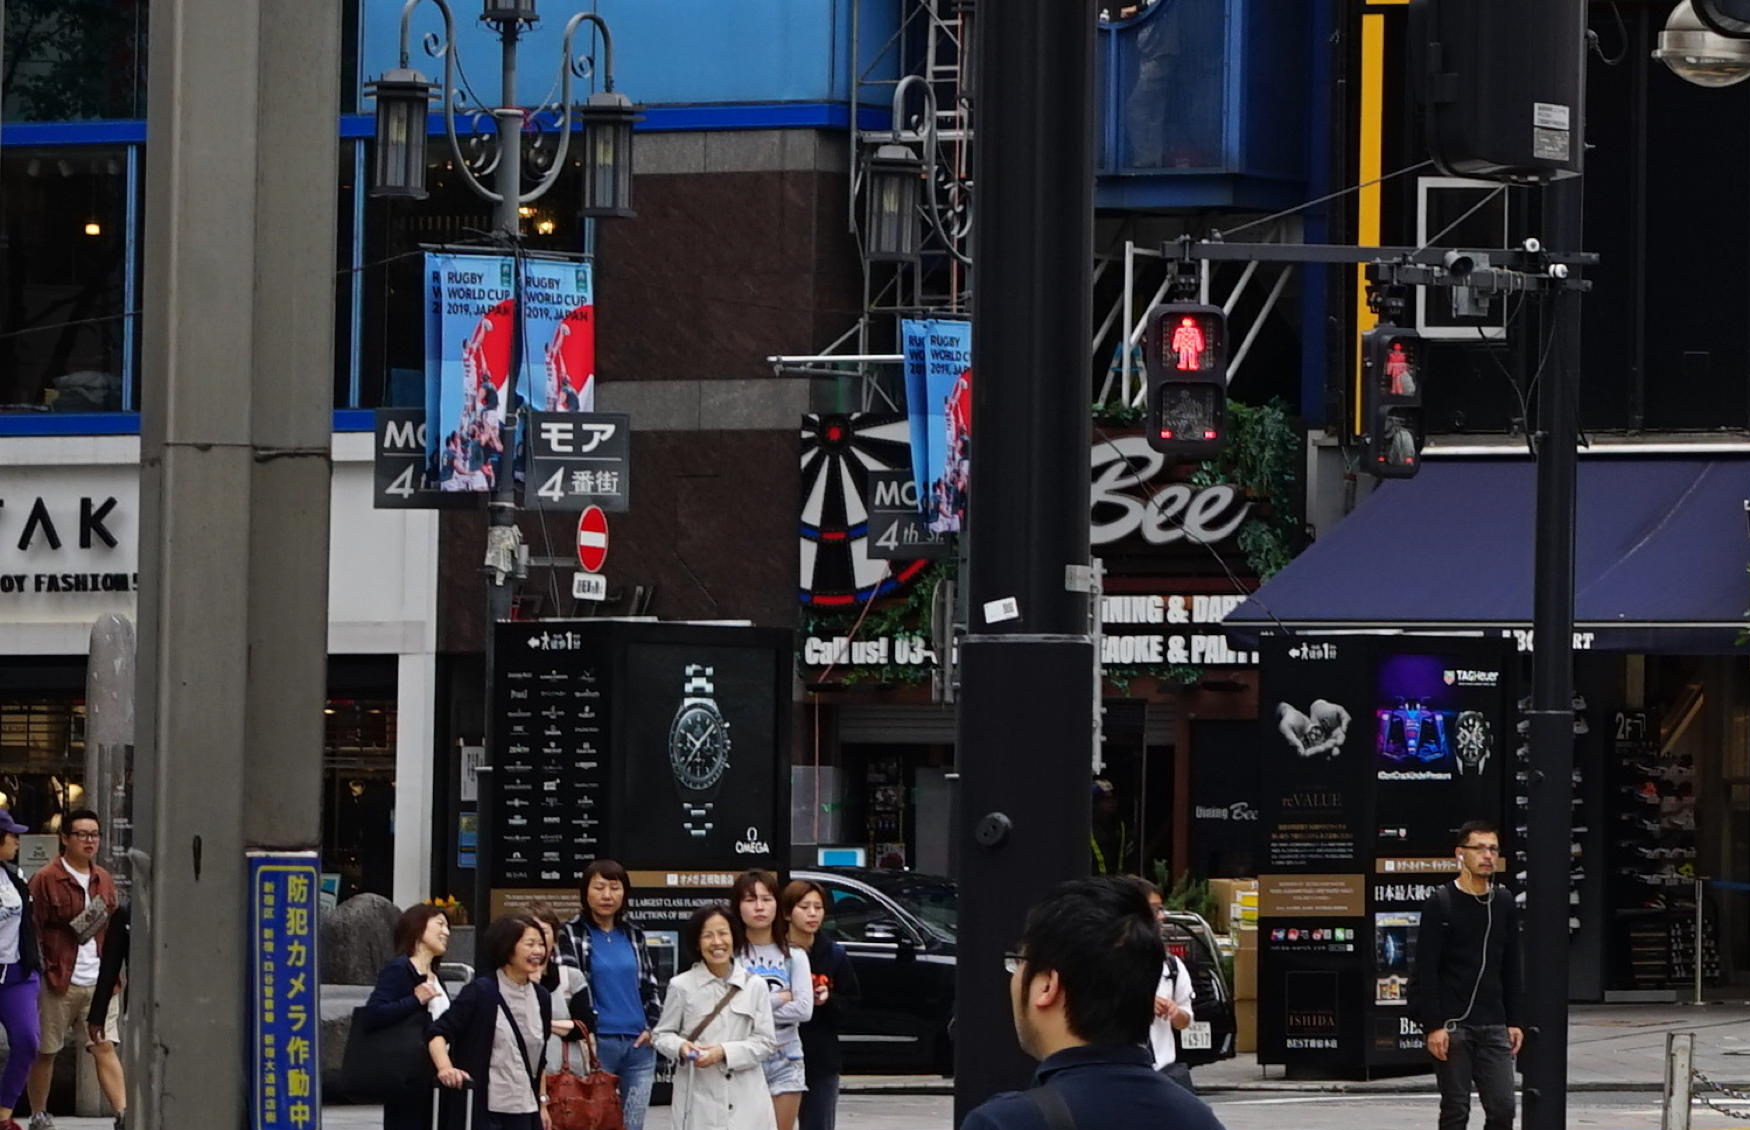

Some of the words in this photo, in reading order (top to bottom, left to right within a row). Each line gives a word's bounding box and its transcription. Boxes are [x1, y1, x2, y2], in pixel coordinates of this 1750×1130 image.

[447, 272, 484, 284] RUGBY
[525, 276, 561, 289] RUGBY
[447, 288, 486, 299] WORLD
[487, 289, 511, 300] CUP
[525, 292, 563, 305] WORLD
[565, 295, 587, 306] CUP
[930, 336, 960, 347] RUGBY
[540, 422, 616, 453] モア
[1090, 436, 1253, 545] Bee
[1166, 595, 1189, 624] &
[804, 636, 850, 665] Call
[851, 635, 889, 664] us!
[1166, 635, 1189, 664] &
[1196, 805, 1228, 820] Dining
[1230, 802, 1259, 821] Bee
[735, 841, 770, 854] OMEGA
[286, 874, 310, 1130] 防犯カメラ作動中
[1289, 1015, 1335, 1027] ISHIDA
